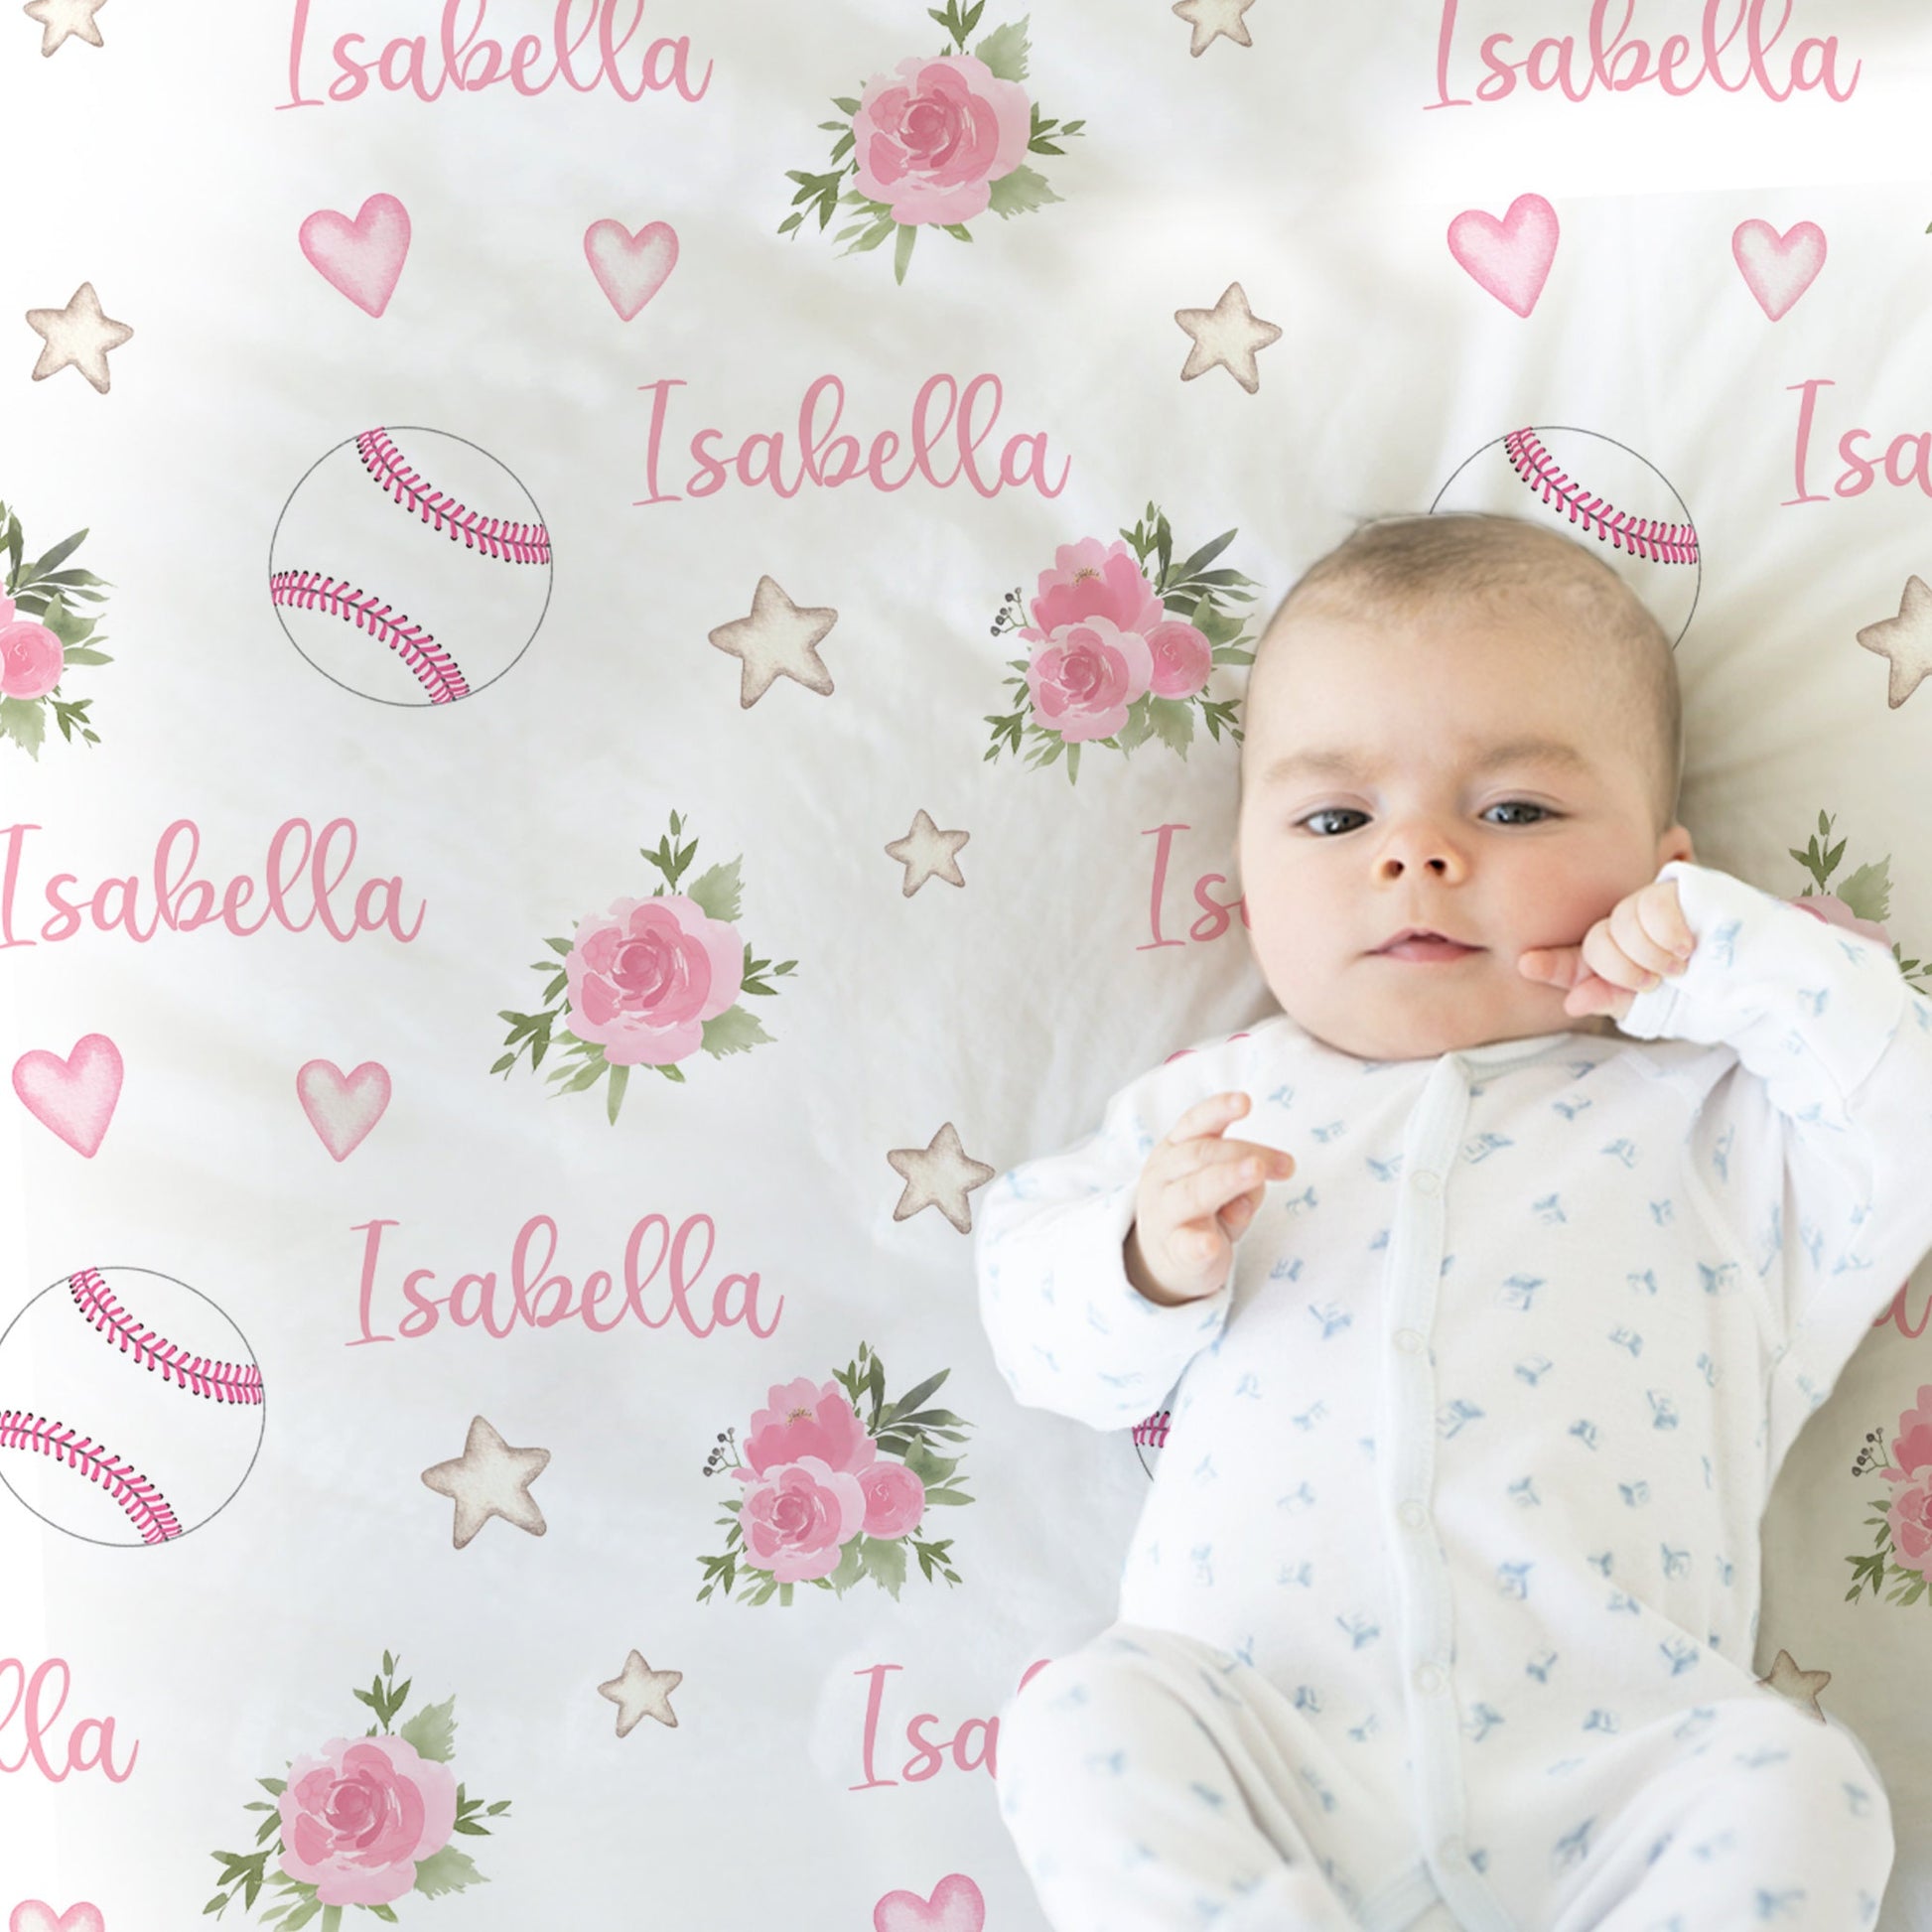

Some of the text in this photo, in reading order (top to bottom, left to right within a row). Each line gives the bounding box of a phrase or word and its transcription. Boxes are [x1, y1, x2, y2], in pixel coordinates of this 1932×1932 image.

[275, 0, 714, 110] Isabella
[1423, 0, 1863, 110] Isabella
[632, 372, 1072, 506] Isabella
[0, 817, 427, 950] Isabella
[345, 1213, 784, 1346] Isabella
[848, 1658, 1050, 1791] Isa
